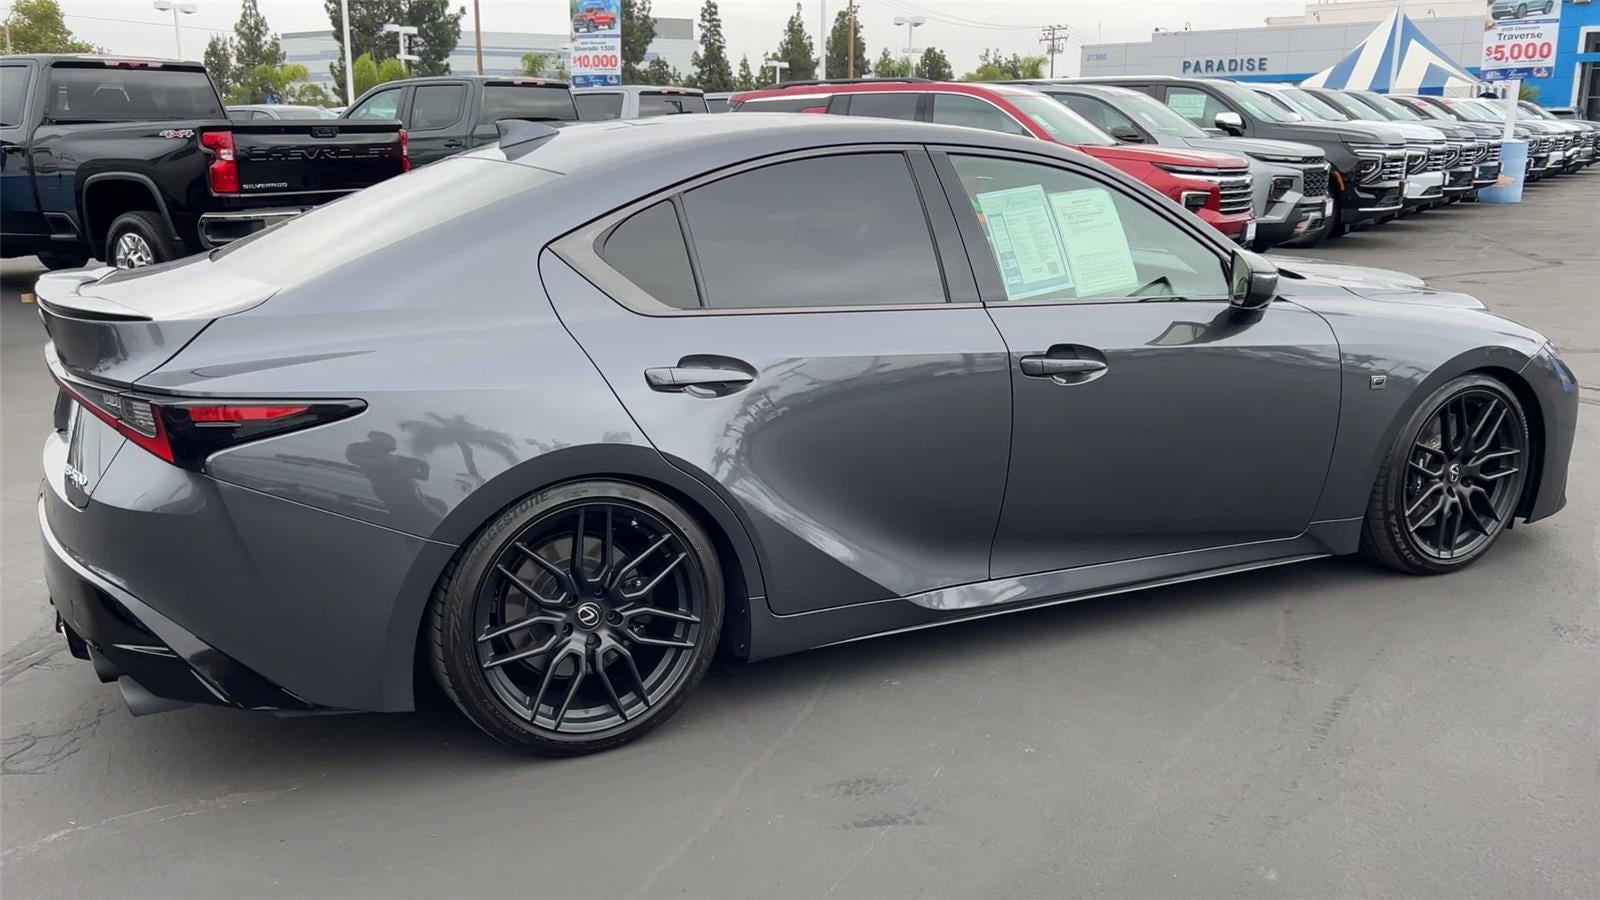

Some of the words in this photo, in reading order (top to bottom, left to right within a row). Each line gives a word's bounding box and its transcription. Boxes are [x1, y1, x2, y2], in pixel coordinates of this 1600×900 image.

[1497, 31, 1543, 41] Traverse
[1485, 41, 1552, 62] $5,000
[573, 54, 618, 68] $10,000
[1182, 57, 1269, 74] PARADISE
[249, 146, 393, 161] CHEVROLET
[242, 182, 288, 190] SILVERADO
[470, 493, 549, 560] IDGESTONE
